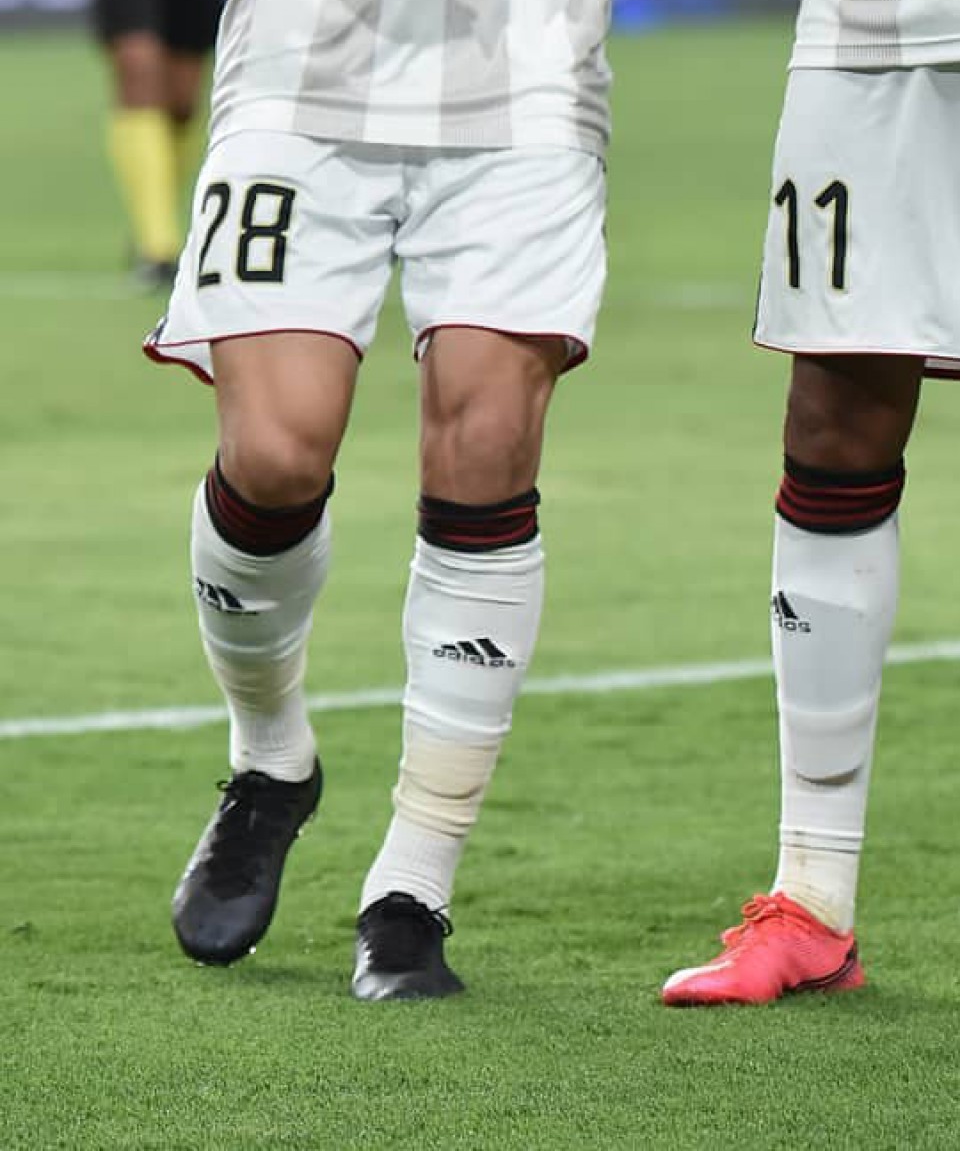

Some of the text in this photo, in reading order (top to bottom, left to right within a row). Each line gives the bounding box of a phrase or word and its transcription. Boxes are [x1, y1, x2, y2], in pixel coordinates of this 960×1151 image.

[197, 180, 297, 288] 28
[775, 178, 848, 290] 11
[432, 648, 516, 668] adidas
